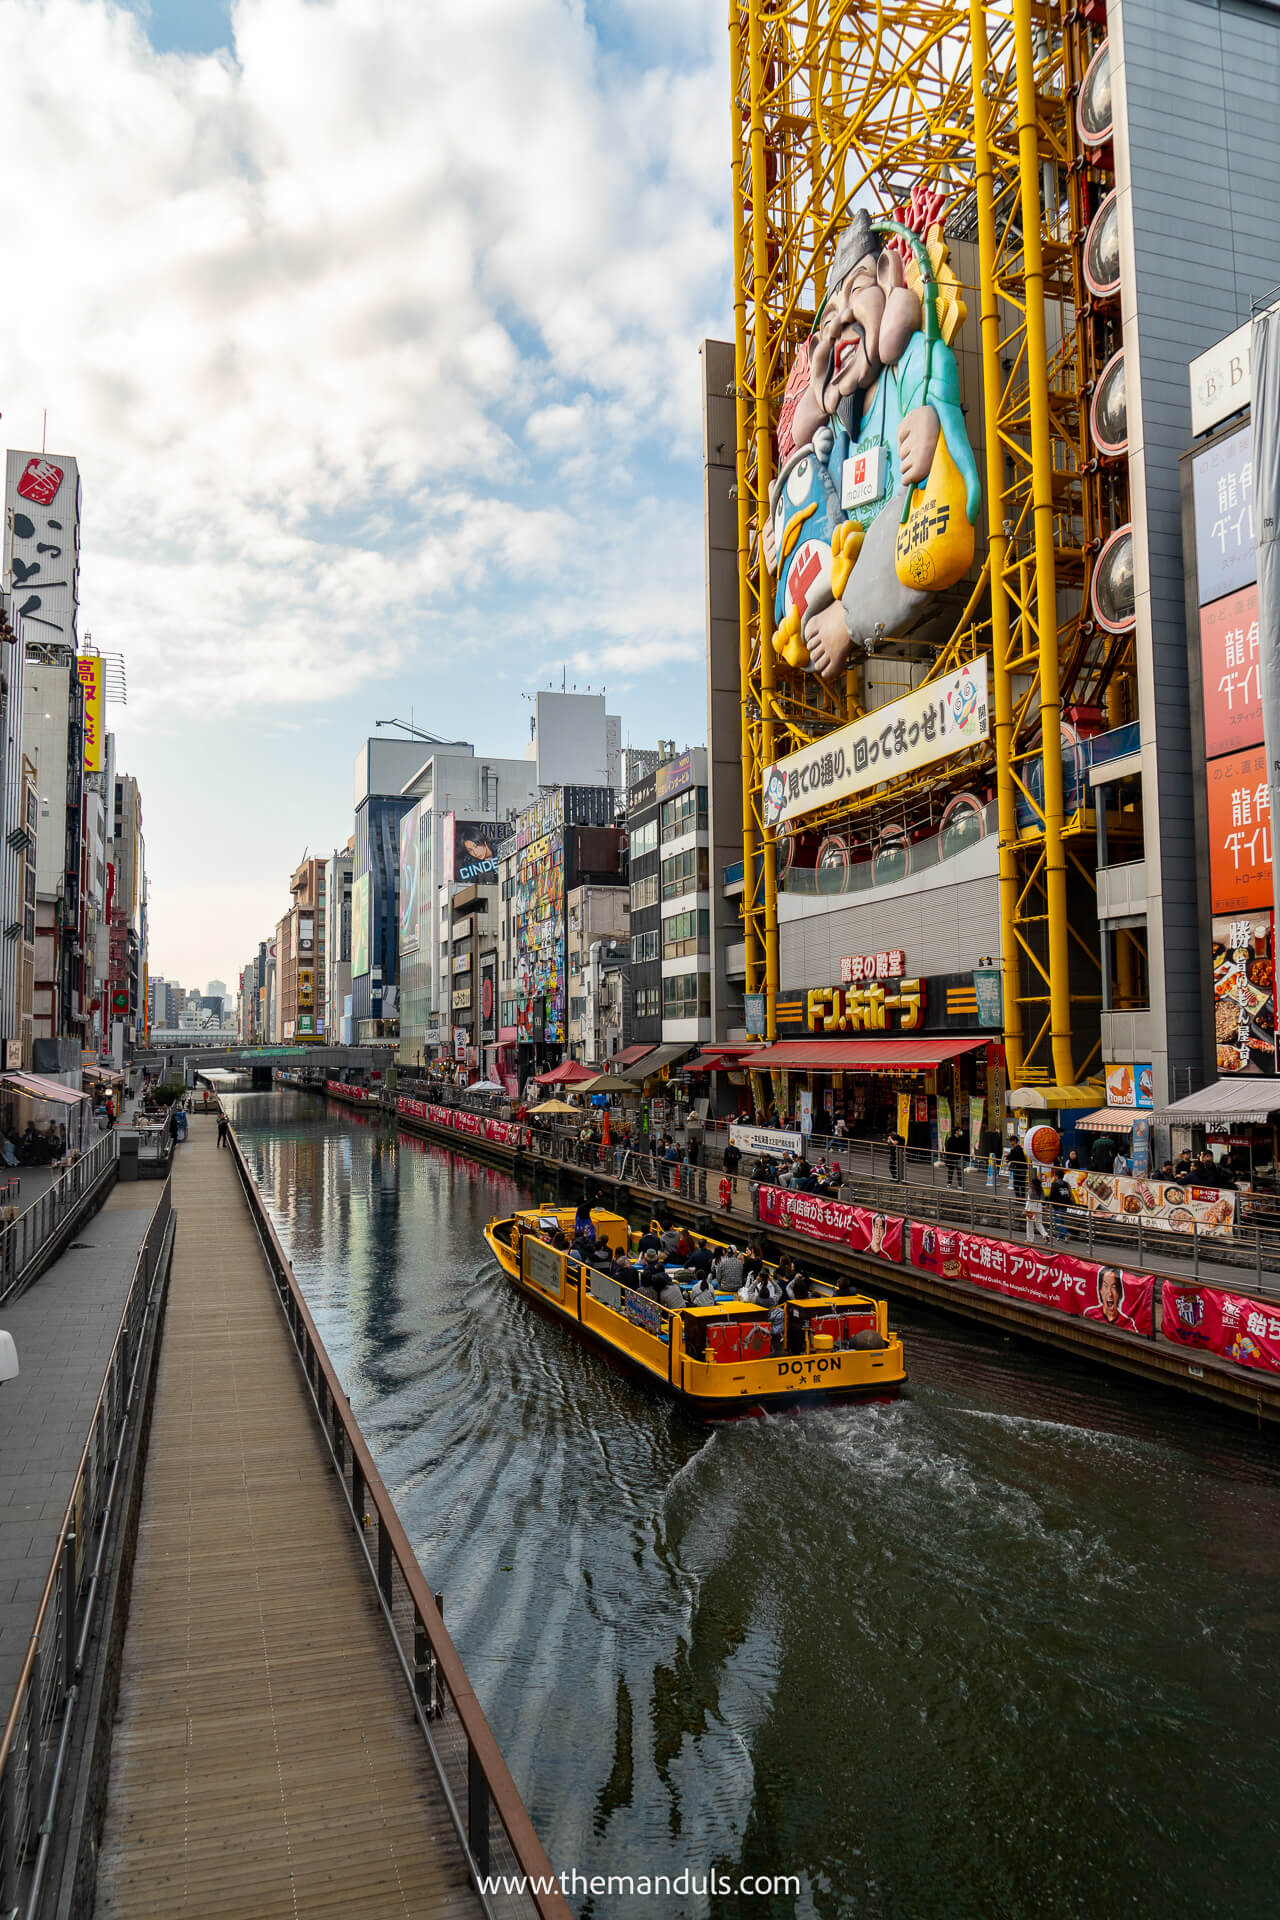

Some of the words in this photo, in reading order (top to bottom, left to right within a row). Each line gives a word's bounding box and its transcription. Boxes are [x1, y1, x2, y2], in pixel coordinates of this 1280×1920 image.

[1229, 347, 1251, 386] B
[840, 949, 906, 983] 驚安の殿堂
[1010, 1255, 1087, 1296] アツアツやで
[777, 1357, 842, 1376] DOTON
